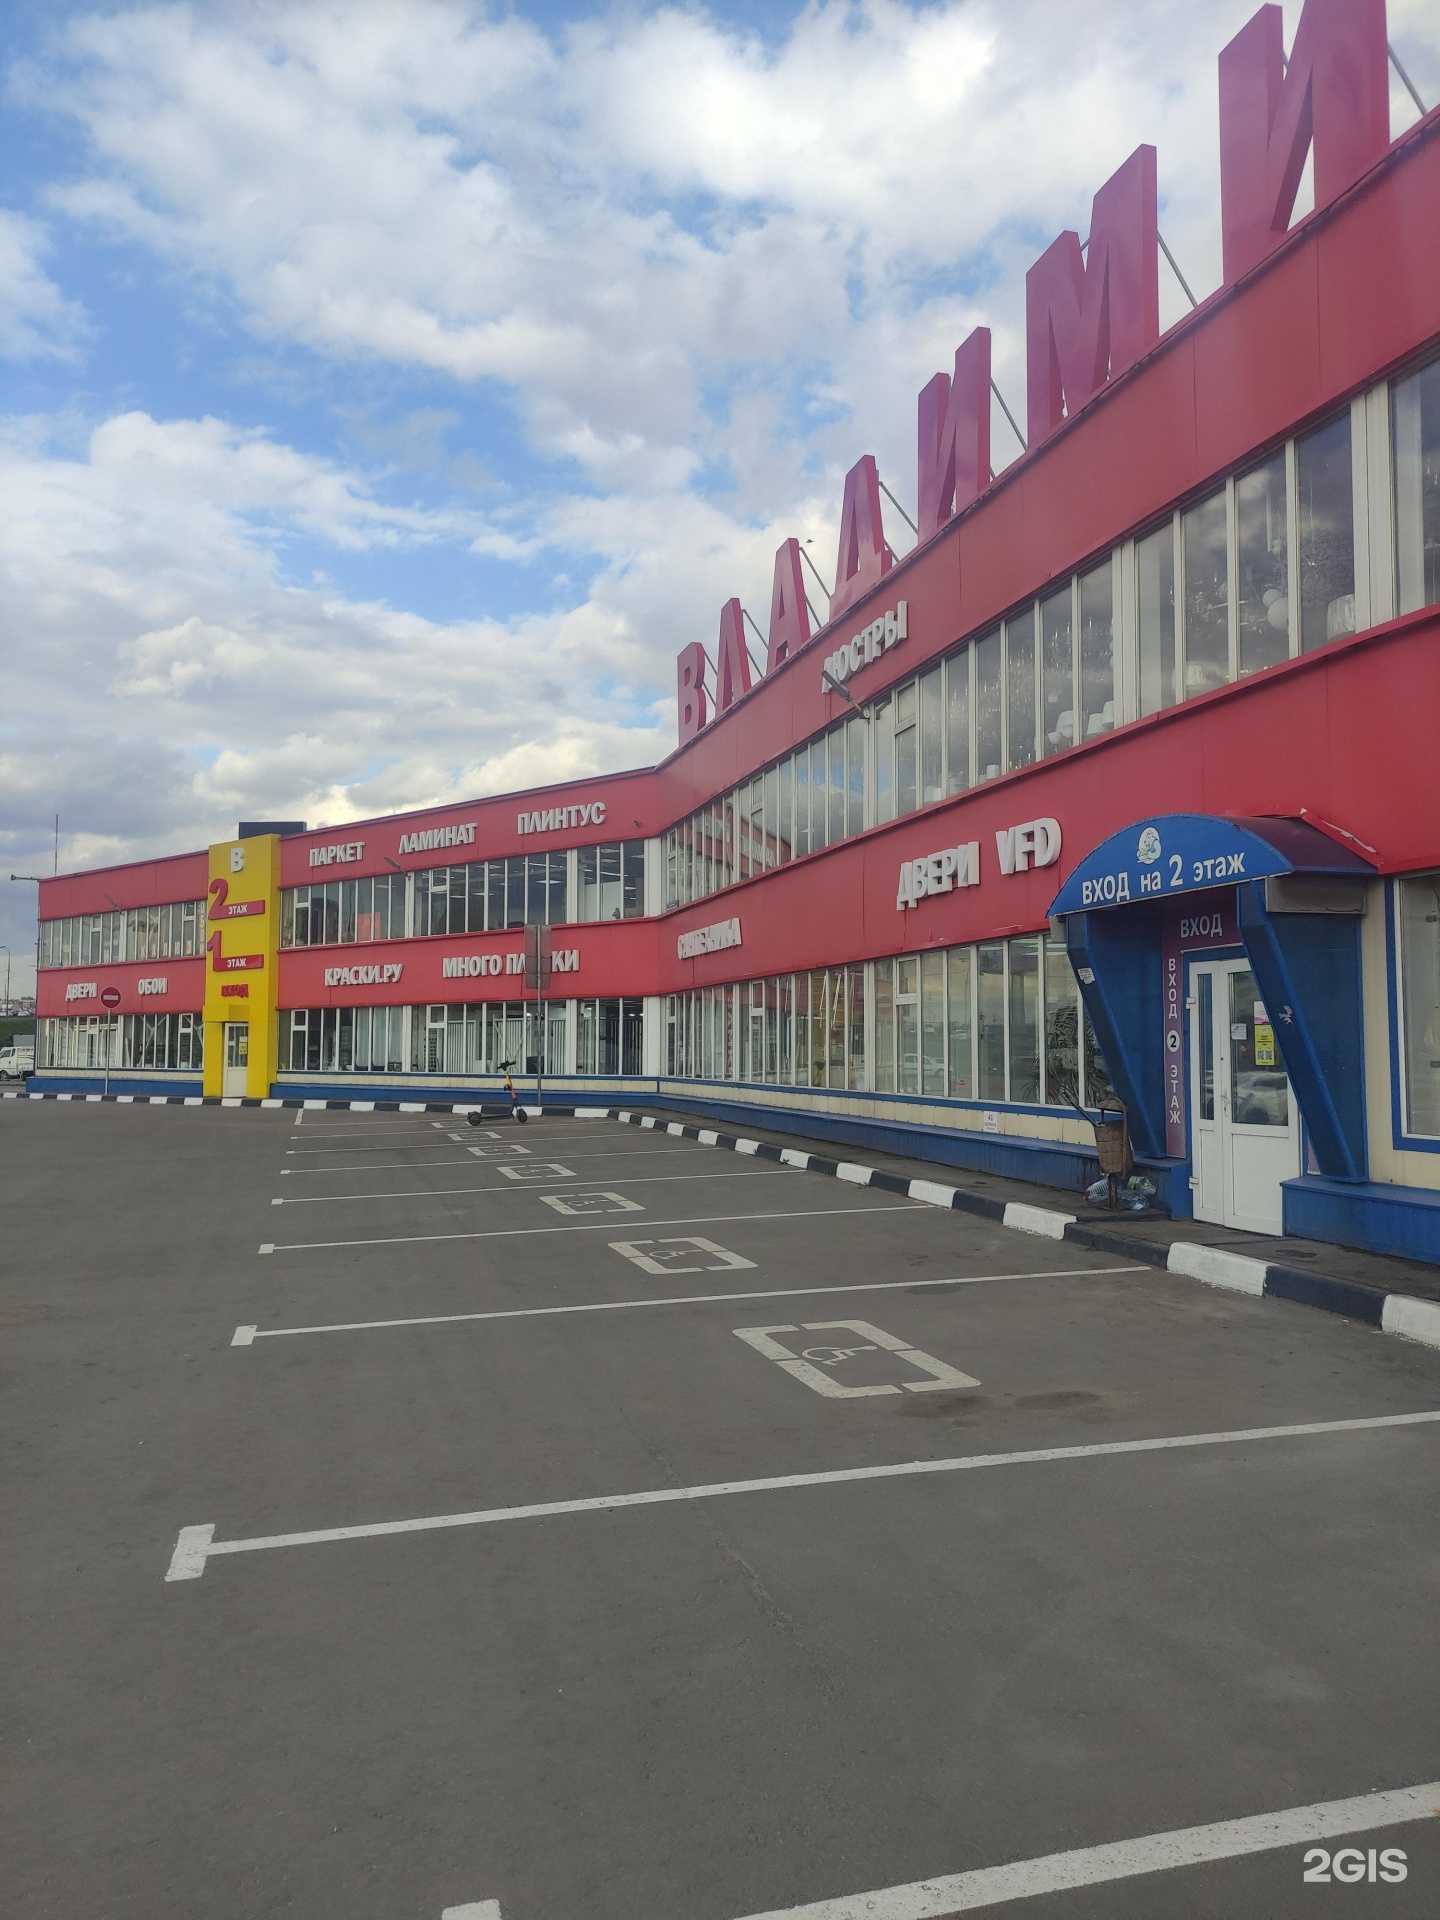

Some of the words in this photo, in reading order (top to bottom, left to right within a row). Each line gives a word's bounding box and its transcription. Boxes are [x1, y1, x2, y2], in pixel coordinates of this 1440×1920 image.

[517, 802, 607, 835] ПЛИНТУС
[398, 823, 478, 855] ЛАМИНАТ
[230, 847, 245, 872] В
[309, 841, 366, 867] ПАРКЕТ
[896, 841, 981, 911] ДВЕРИ
[1082, 871, 1130, 904] ВХОД
[1141, 872, 1161, 893] на
[1170, 854, 1183, 887] 2
[1193, 852, 1246, 882] этаж
[208, 878, 229, 920] 2
[228, 904, 248, 915] ЭТАЖ
[1180, 913, 1223, 939] ВХОД
[227, 957, 247, 968] ЭТАЖ
[324, 964, 404, 988] КРАСКИ.РУ
[442, 954, 501, 978] МНОГО
[506, 949, 580, 976] ПЛКИ
[65, 982, 97, 1001] ДВЕРИ
[138, 977, 168, 995] ОБОИ
[1167, 957, 1178, 1020] ВХОД
[1169, 1065, 1182, 1125] ЭТАЖ
